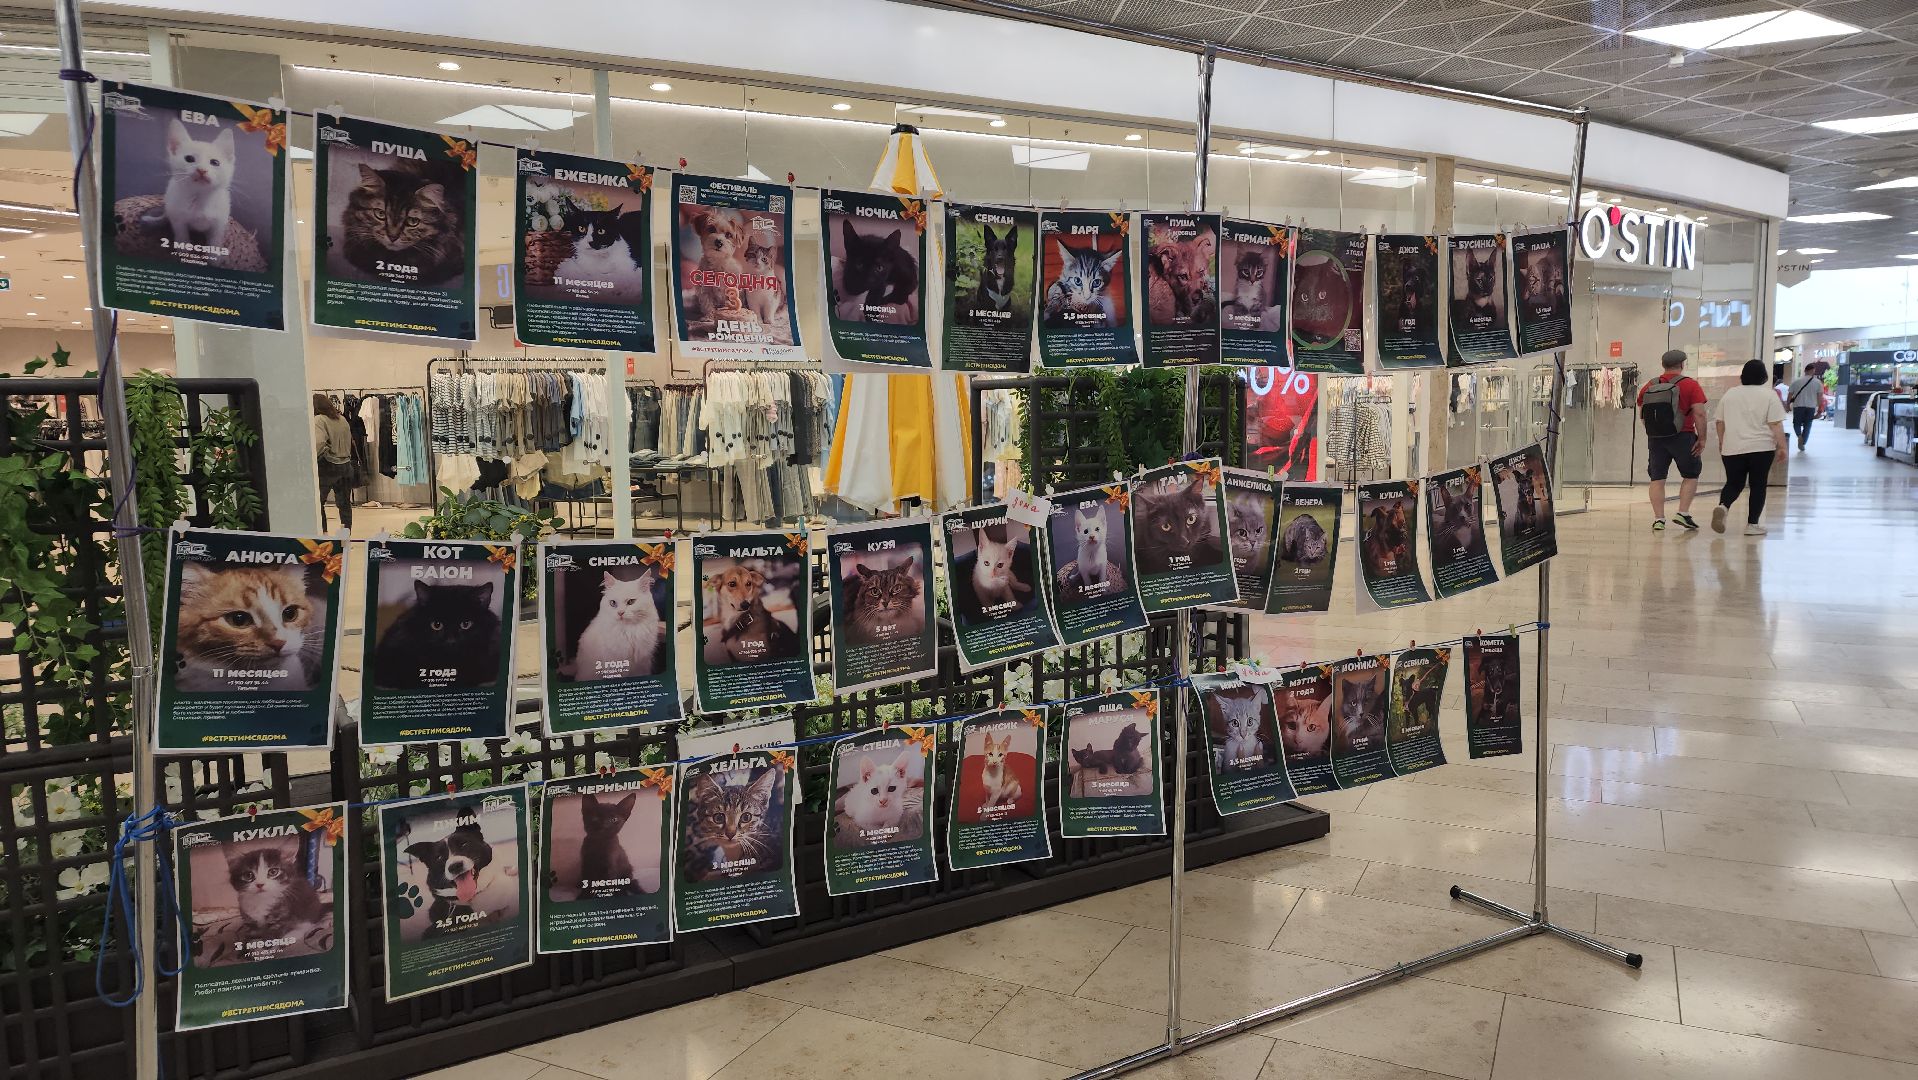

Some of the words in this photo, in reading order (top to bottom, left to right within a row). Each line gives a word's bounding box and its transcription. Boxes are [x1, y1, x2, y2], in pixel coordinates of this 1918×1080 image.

[181, 110, 220, 128] ЕВА
[372, 140, 427, 161] ПУША
[554, 168, 628, 188] ЕЖЕВИКА
[710, 182, 757, 194] ФЕСТИВАЛЬ
[856, 206, 898, 220] НОЧКА
[1169, 218, 1195, 228] ПУША
[1071, 225, 1099, 235] ВАРЯ
[1234, 233, 1271, 246] ГЕРМАН
[1459, 239, 1496, 249] БУСИНКА
[1578, 205, 1696, 271] O'STIN
[160, 238, 170, 248] 2
[174, 241, 229, 256] месяца
[376, 261, 384, 270] 2
[387, 262, 418, 274] года
[566, 279, 614, 289] месяцев
[689, 270, 777, 291] СЕГОДНЯ
[859, 303, 865, 312] 3
[866, 304, 897, 314] месяца
[717, 320, 763, 333] ДЕНЬ
[708, 332, 773, 343] РОЖДЕНИЯ
[1160, 472, 1188, 487] ТАЙ
[1227, 478, 1273, 493] АНЖЕЛИКА
[1445, 474, 1465, 489] ГРЕЙ
[1079, 499, 1098, 510] ЕВА
[1295, 498, 1323, 506] ВЕНЕРА
[971, 516, 1009, 529] ШУРИК
[729, 546, 784, 558] МАЛЬТА
[867, 539, 896, 552] КУЗЯ
[225, 550, 299, 565] АНЮТА
[423, 545, 464, 560] КОТ
[588, 555, 639, 567] СНЕЖА
[410, 565, 473, 580] БАЮН
[1078, 585, 1084, 593] 2
[981, 605, 989, 614] 2
[989, 600, 1017, 612] месяца
[740, 640, 746, 648] 1
[747, 640, 765, 648] год
[596, 661, 602, 670] 2
[605, 660, 629, 668] года
[1403, 658, 1430, 669] СЕВИЛЬ
[212, 668, 224, 678] 11
[227, 669, 289, 679] месяцев
[429, 669, 457, 677] года
[1296, 688, 1314, 696] года
[1098, 704, 1123, 713] ЯША
[979, 721, 1018, 733] МАКСИК
[862, 739, 900, 752] СТЕША
[709, 756, 768, 775] ХЕЛЬГА
[578, 781, 641, 795] ЧЕРНЫШ
[233, 824, 298, 843] КУКЛА
[712, 861, 718, 869] 3
[582, 880, 588, 889] 3
[591, 878, 631, 888] месяца
[435, 919, 453, 928] 2,5
[455, 910, 487, 924] ГОДА
[234, 941, 243, 951] 3
[246, 937, 296, 950] месяца
